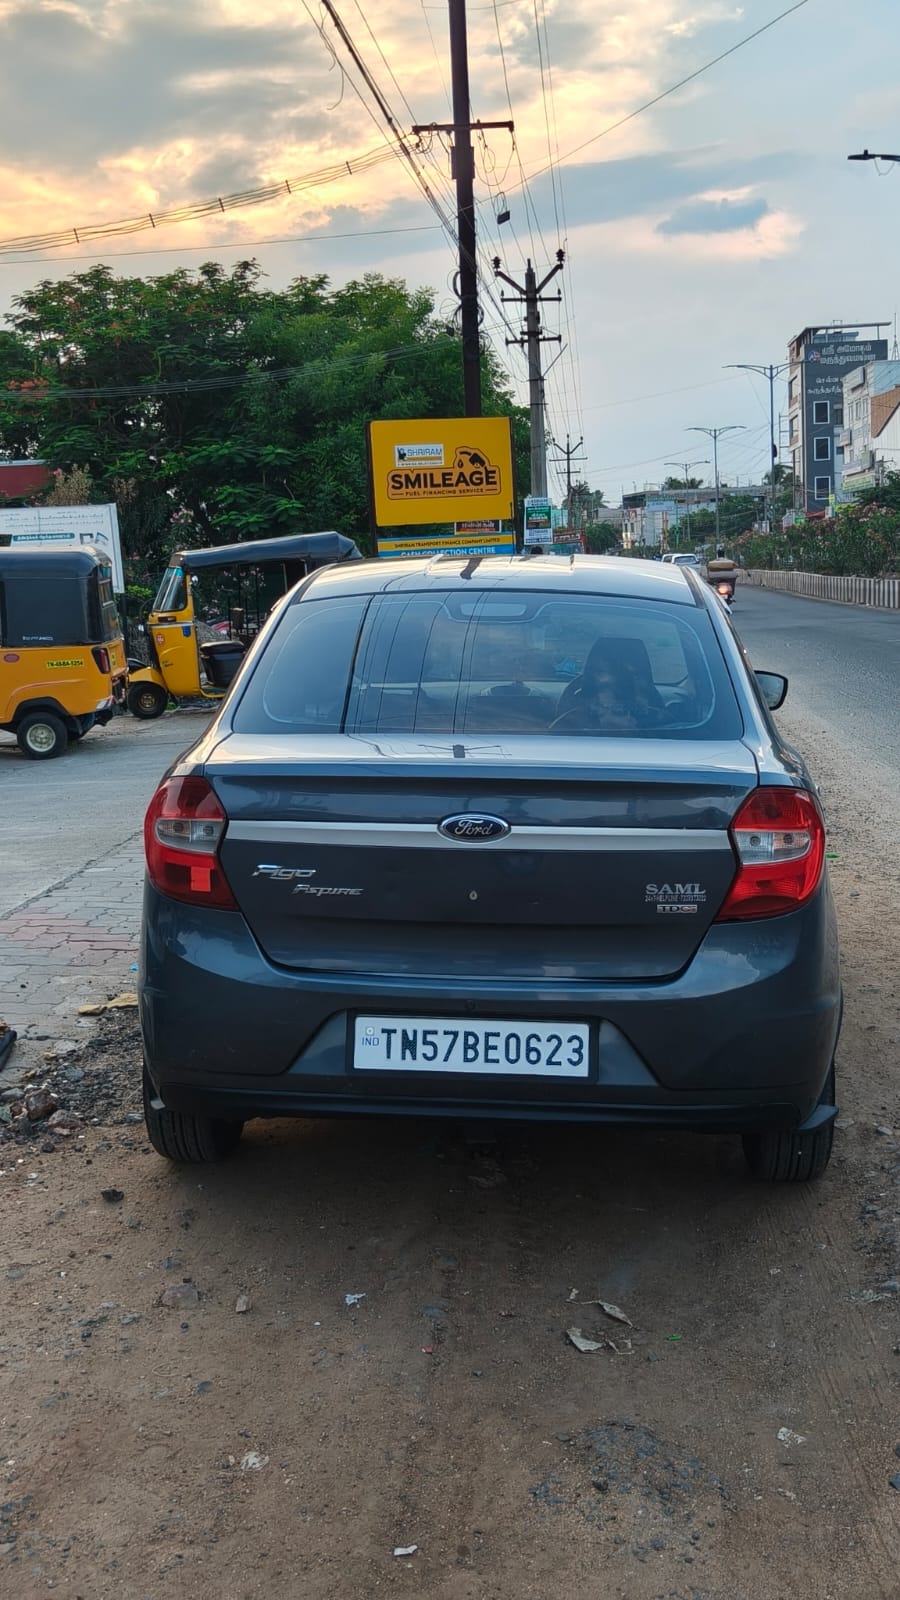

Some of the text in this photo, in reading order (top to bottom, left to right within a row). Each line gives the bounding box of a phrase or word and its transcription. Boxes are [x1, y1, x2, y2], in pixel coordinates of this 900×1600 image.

[407, 447, 442, 457] SHRIRAM
[391, 469, 497, 490] SMILEAGE
[415, 540, 441, 548] TRANSPORT
[462, 538, 484, 546] COMPANY
[469, 546, 496, 555] CENTRE
[454, 819, 494, 835] Ford
[251, 864, 317, 880] Figo
[645, 883, 706, 895] SAML
[361, 1037, 380, 1046] IND
[381, 1028, 584, 1067] TN57BE0623
